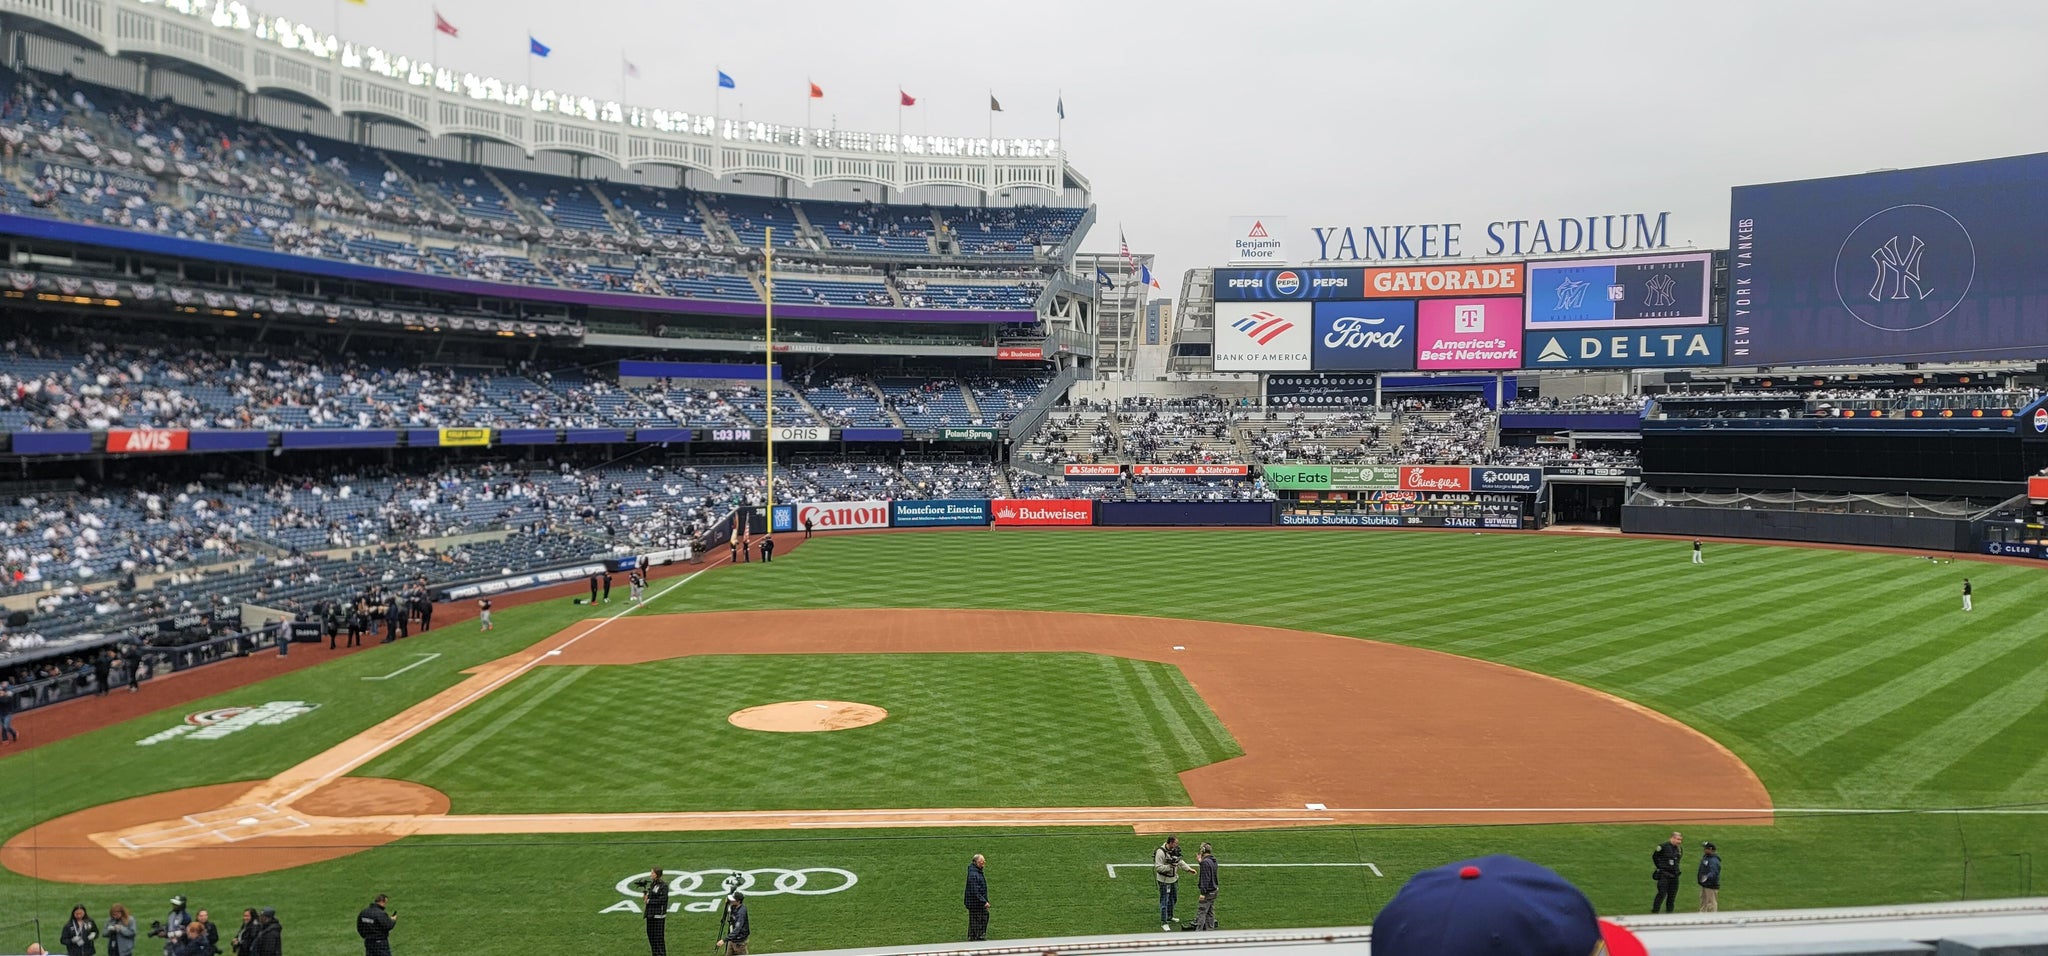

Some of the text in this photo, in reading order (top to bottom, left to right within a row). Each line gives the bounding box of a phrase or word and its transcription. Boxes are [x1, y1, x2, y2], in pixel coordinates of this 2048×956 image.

[1311, 211, 1671, 261] YANKEE STADIUM
[1235, 239, 1281, 249] Benjamin
[1241, 249, 1273, 258] Moore
[1228, 279, 1263, 288] PEPSI
[1313, 278, 1348, 287] PEPSI
[1373, 269, 1515, 292] GATORADE
[1608, 286, 1623, 299] VS
[1735, 278, 1751, 316] YORK
[1324, 316, 1405, 348] Ford
[1432, 339, 1506, 350] America's
[1580, 334, 1711, 359] DELTA
[1734, 326, 1750, 356] NEW
[1261, 353, 1308, 361] AMERICA
[1420, 349, 1518, 360] Best Network
[712, 430, 751, 440] 1:03 PM
[781, 428, 818, 440] ORIS
[945, 429, 993, 439] Poland Spring
[126, 431, 172, 450] AVIS
[1298, 473, 1328, 483] Eats
[1497, 472, 1530, 484] coupa
[897, 504, 982, 514] Montefiore Einstein
[1019, 508, 1087, 520] Budweiser
[799, 506, 886, 526] Canon
[1283, 516, 1319, 525] StubHub
[1322, 516, 1358, 525] StubHub
[1361, 516, 1398, 525] StubHub
[1444, 518, 1477, 527] STARR
[2005, 545, 2030, 553] CLEAR
